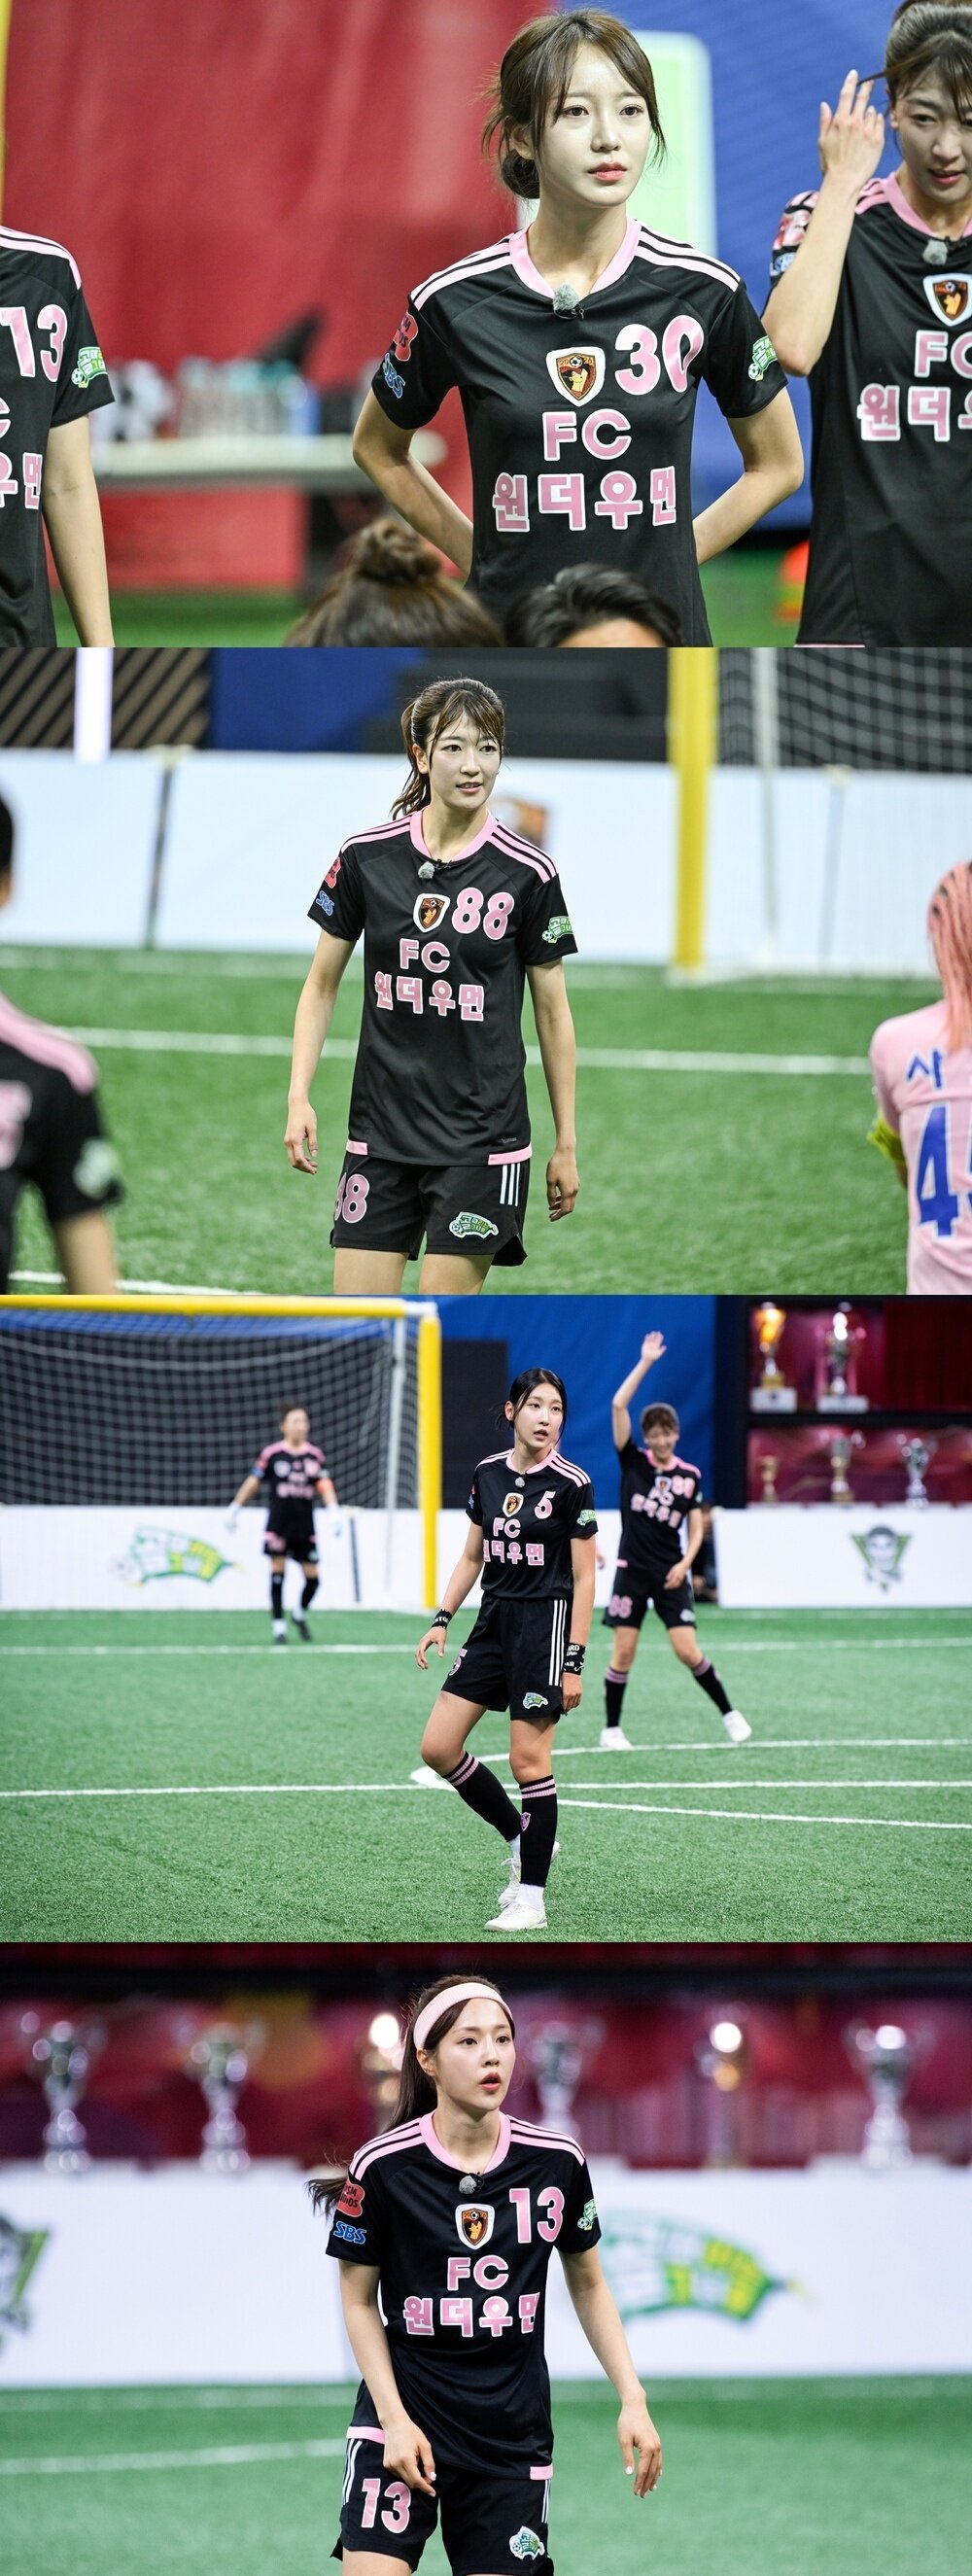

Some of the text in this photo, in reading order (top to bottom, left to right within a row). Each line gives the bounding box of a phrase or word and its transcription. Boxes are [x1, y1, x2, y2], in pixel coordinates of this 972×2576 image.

[0, 304, 68, 383] 13
[614, 315, 705, 396] 30
[541, 408, 632, 462] FC
[492, 466, 677, 533] 원더우먼
[315, 889, 335, 917] SBS
[451, 887, 515, 941] 88
[399, 938, 451, 973] FC
[374, 971, 484, 1023] 원더우먼
[916, 1102, 972, 1239] 4
[493, 1516, 521, 1539] FC
[534, 1490, 557, 1519] 5
[333, 2220, 367, 2245] SBS
[509, 2186, 565, 2244] 13
[447, 2254, 509, 2291] FC
[403, 2291, 540, 2338] 원더우먼
[361, 2478, 411, 2534] 13
